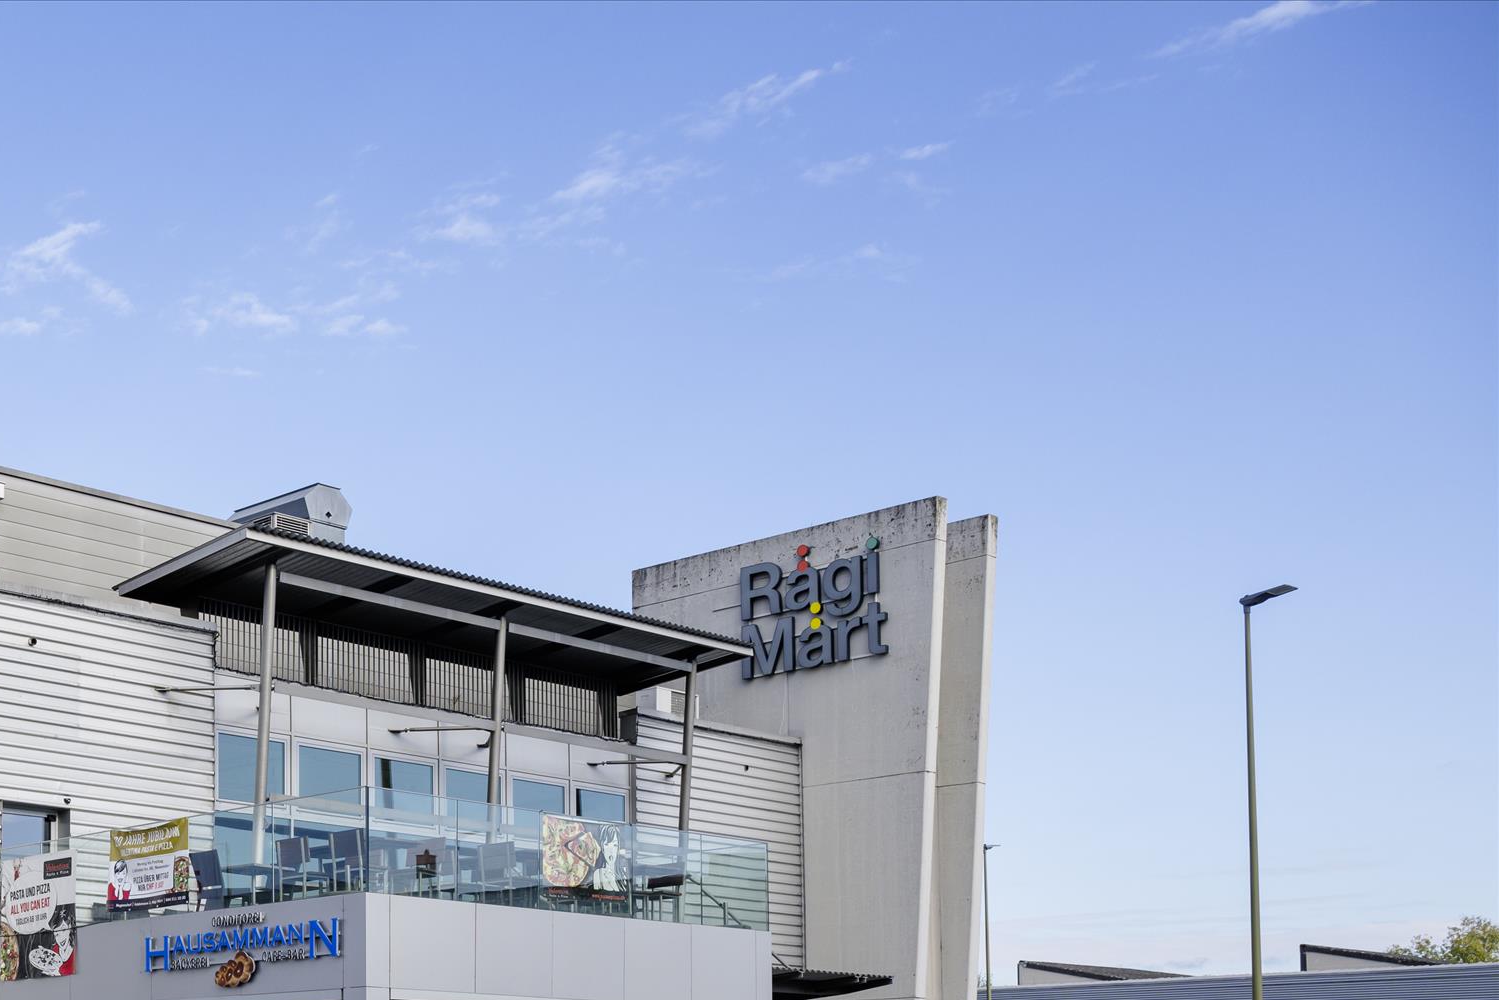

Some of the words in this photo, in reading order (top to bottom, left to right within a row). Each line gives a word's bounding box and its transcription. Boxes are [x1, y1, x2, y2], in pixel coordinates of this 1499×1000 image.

[10, 889, 25, 901] PASTA
[26, 886, 36, 898] UND
[36, 882, 51, 896] PIZZA
[10, 904, 19, 915] ALL
[20, 902, 30, 913] YOU
[30, 899, 41, 911] CAN
[41, 896, 51, 909] EAT
[145, 917, 341, 973] HAUSAMMANN
